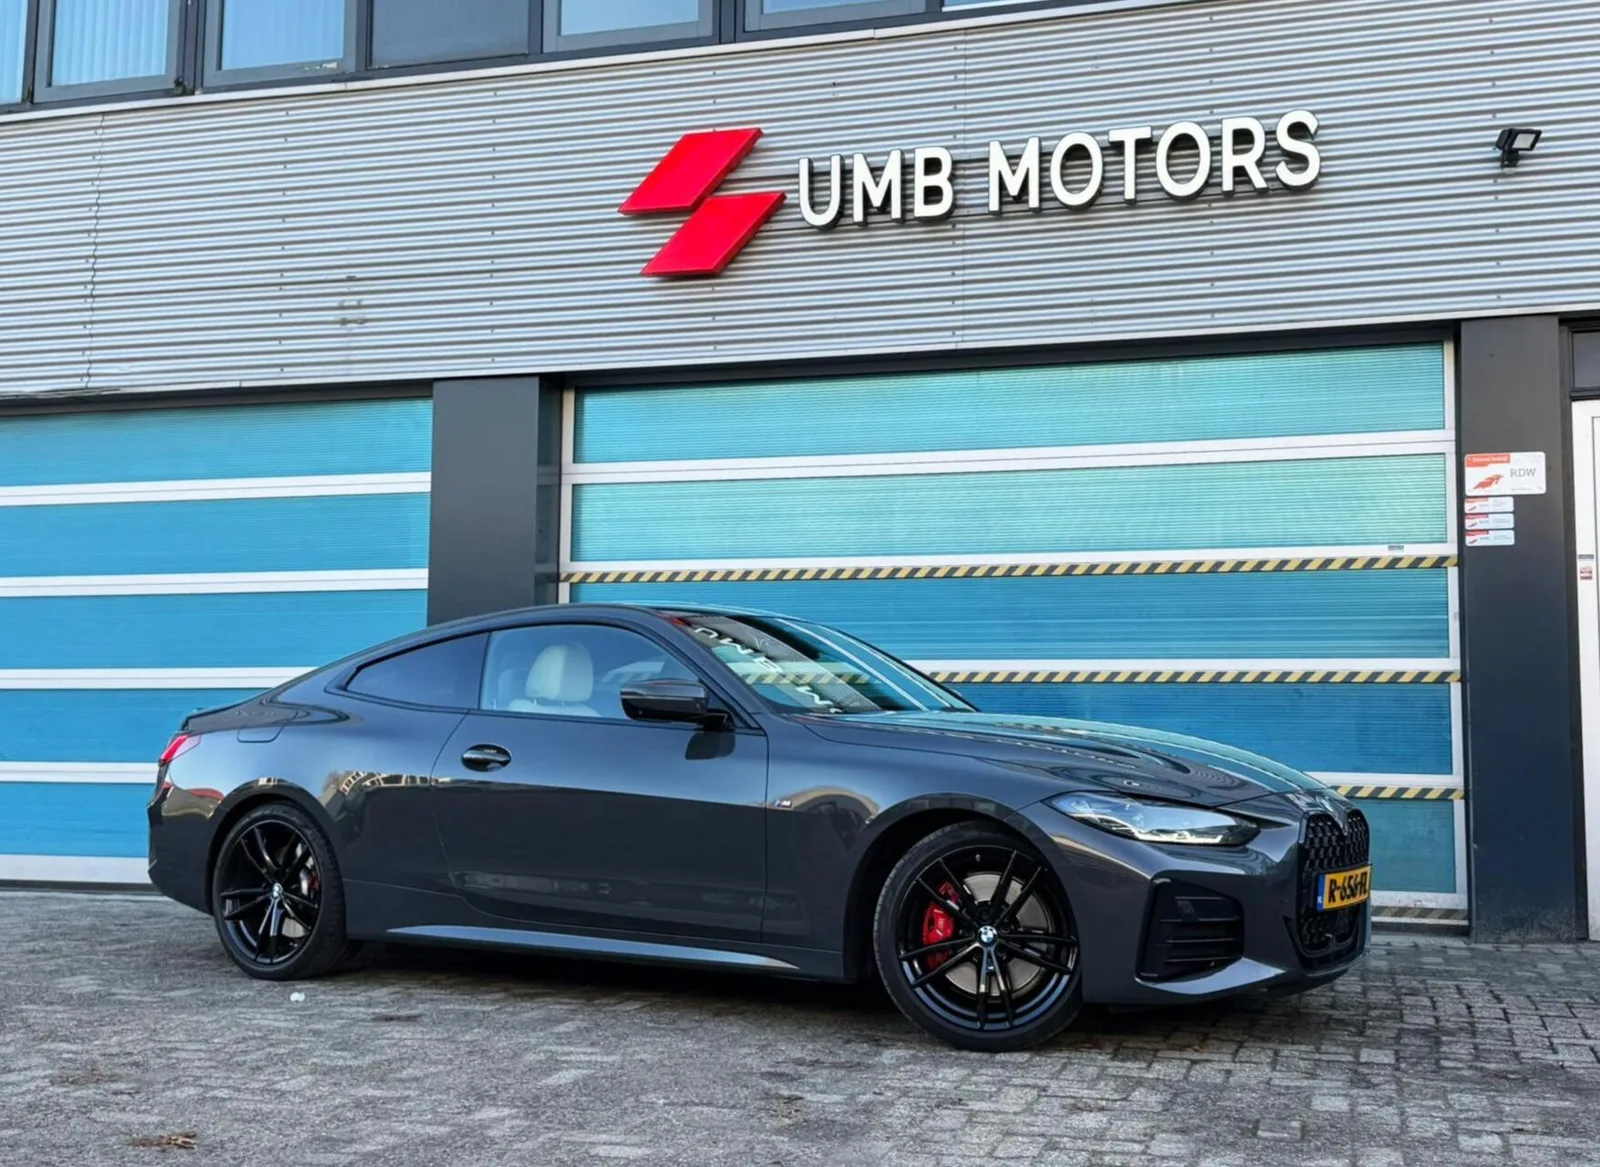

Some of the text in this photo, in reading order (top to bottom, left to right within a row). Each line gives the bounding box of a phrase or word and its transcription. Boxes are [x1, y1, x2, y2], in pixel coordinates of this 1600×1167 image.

[799, 109, 1321, 228] UMB MOTORS
[1510, 468, 1537, 478] RDW
